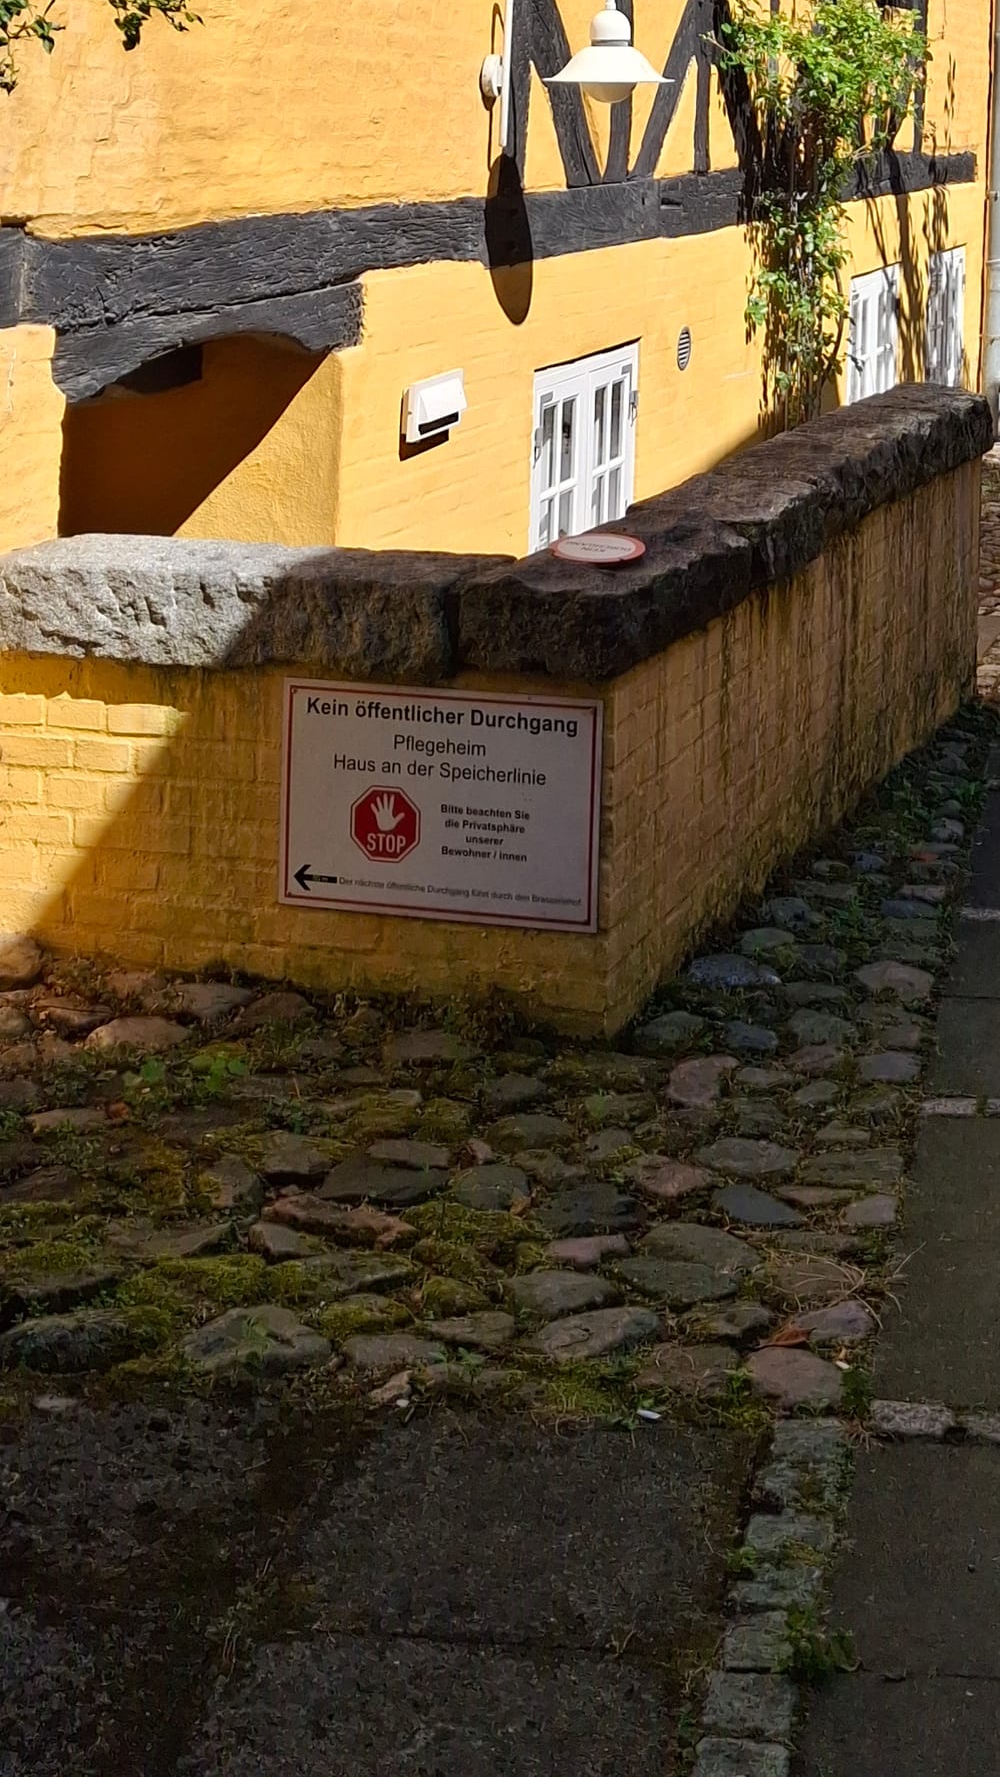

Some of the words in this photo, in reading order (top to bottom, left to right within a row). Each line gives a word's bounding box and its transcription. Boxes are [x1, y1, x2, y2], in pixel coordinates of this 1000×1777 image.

[307, 697, 349, 716] Kein
[355, 700, 465, 724] öffentlicher
[470, 709, 579, 737] Durchgang
[393, 734, 487, 757] Pflegeheim
[334, 754, 376, 773] Haus
[381, 760, 402, 774] an
[407, 760, 434, 777] der
[439, 763, 547, 786] Speicherlinie
[441, 804, 464, 815] Bitte
[466, 806, 512, 820] beachten
[514, 810, 530, 821] Sie
[445, 820, 459, 829] die
[462, 821, 526, 834] Privatsphäre
[367, 833, 407, 854] STOP
[466, 835, 504, 846] unserer
[441, 846, 491, 859] Bewohner
[499, 850, 527, 862] innen
